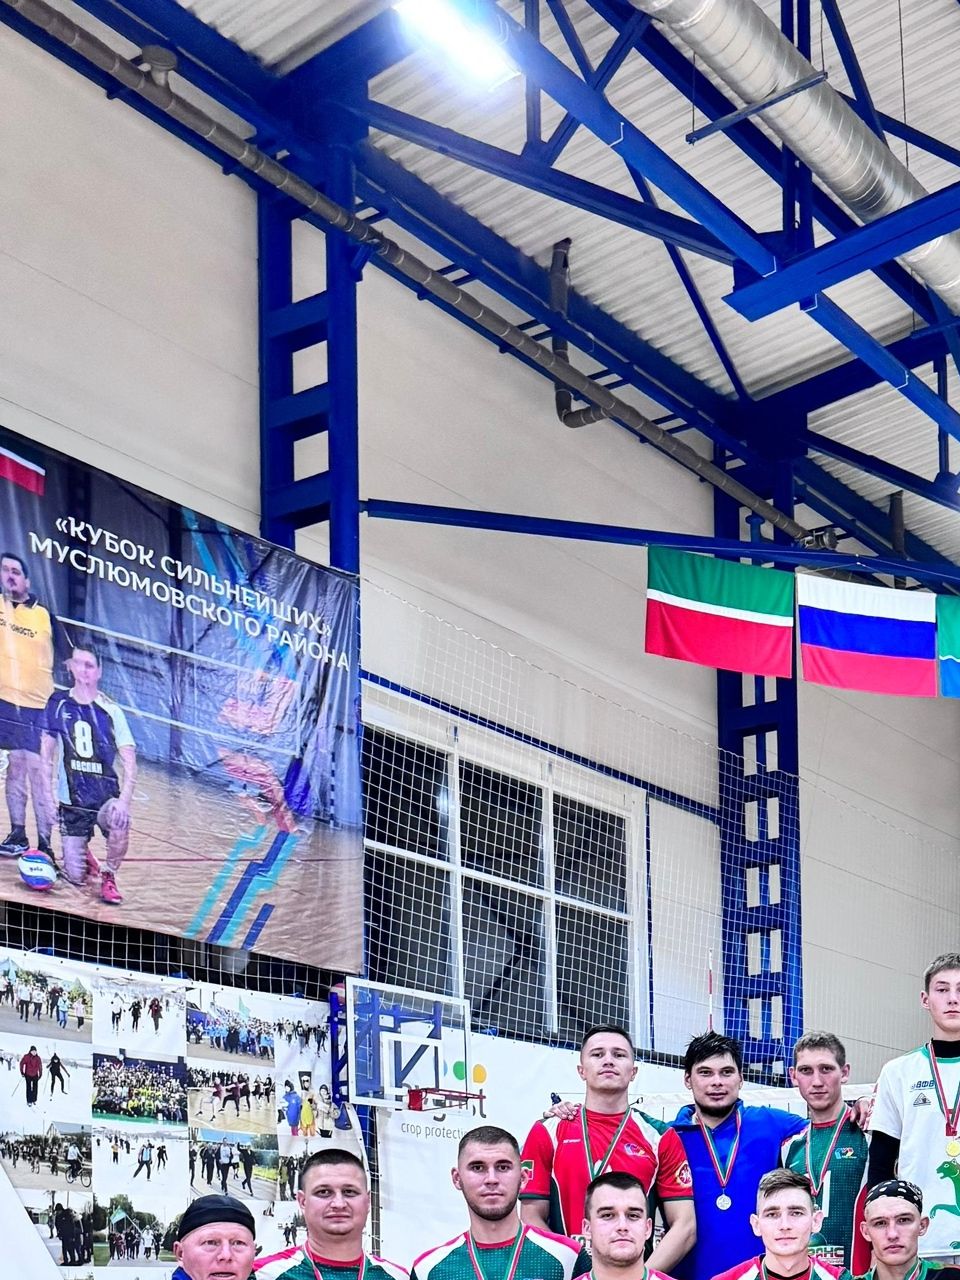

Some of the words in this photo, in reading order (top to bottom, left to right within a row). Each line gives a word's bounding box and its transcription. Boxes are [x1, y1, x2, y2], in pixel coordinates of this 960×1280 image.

[29, 532, 261, 637] МУСЛЮМОВСКОГО
[265, 624, 350, 672] РАЙОНА
[55, 516, 156, 569] «КУБОК
[160, 556, 332, 637] СИЛЬНЕЙШИХ»
[74, 720, 94, 758] 8
[401, 1122, 422, 1139] crop
